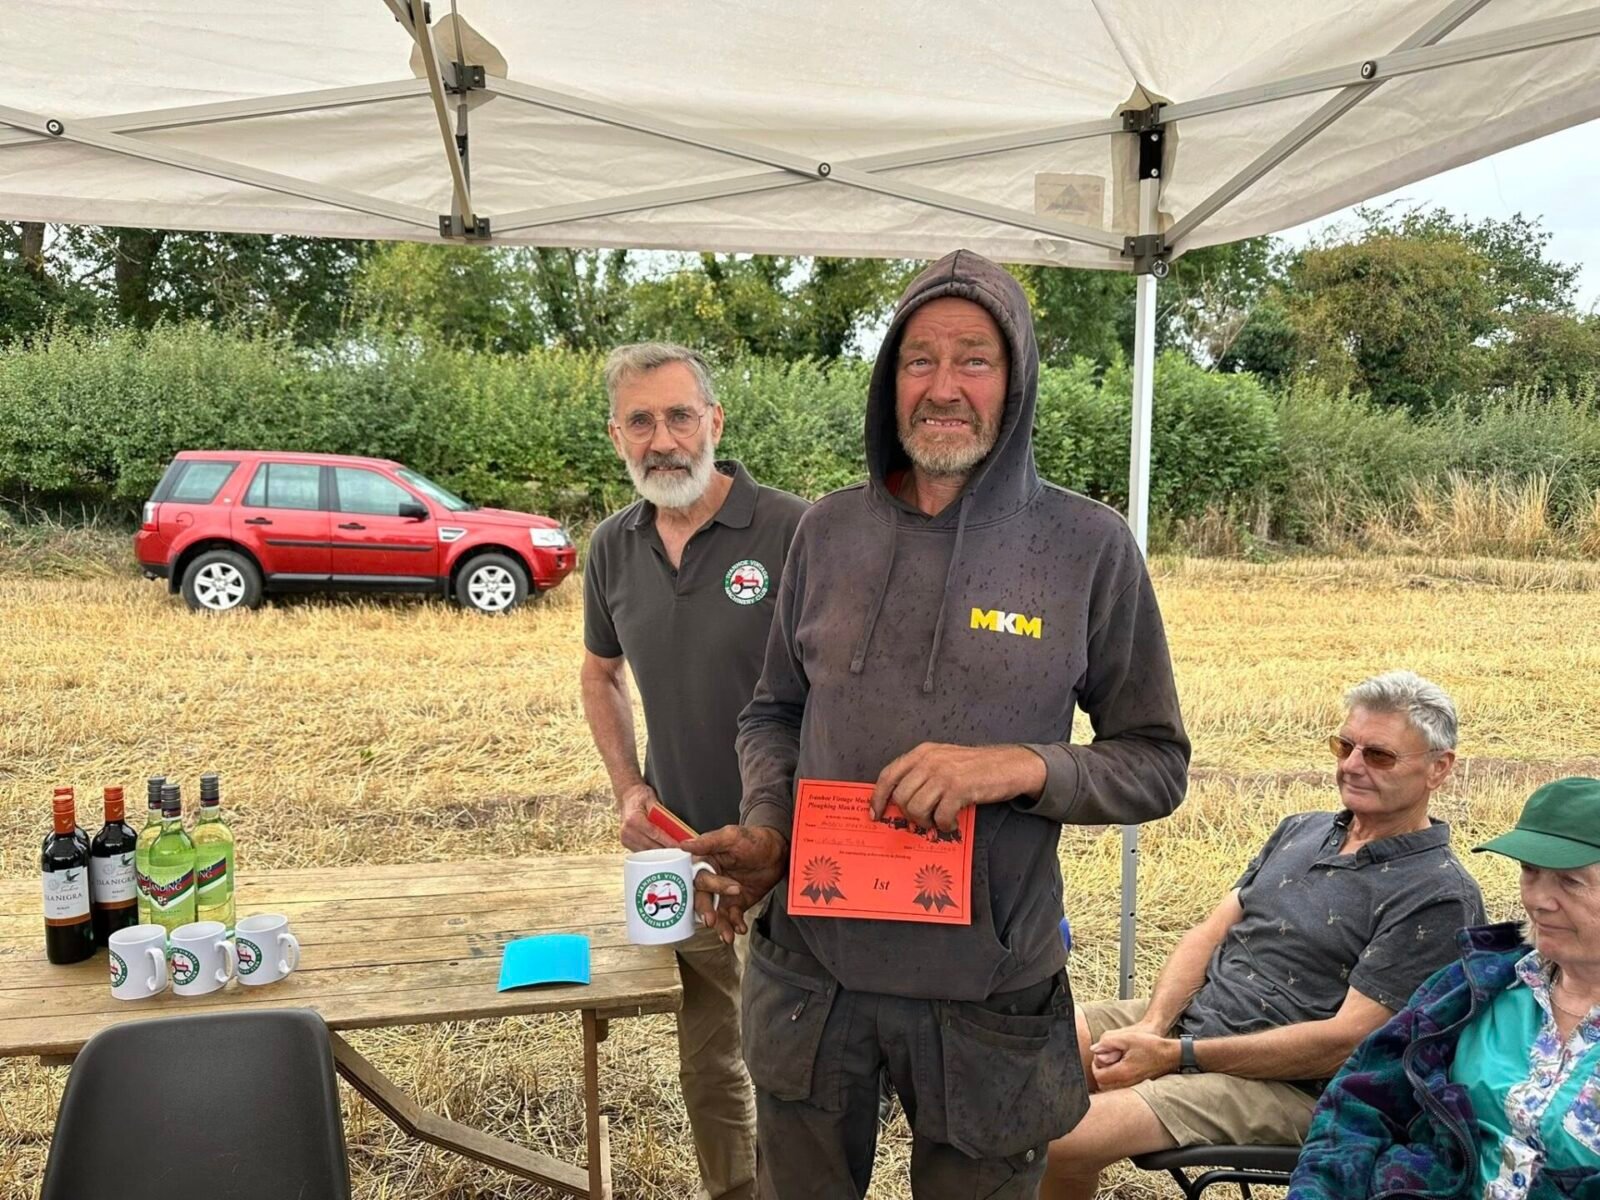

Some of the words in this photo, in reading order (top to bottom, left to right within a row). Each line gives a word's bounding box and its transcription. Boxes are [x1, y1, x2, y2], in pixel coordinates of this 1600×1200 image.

[970, 607, 1042, 639] MKM
[55, 892, 82, 901] NEGRA
[637, 874, 661, 898] IVANHOE
[664, 873, 687, 893] VINTAGE
[872, 878, 890, 891] 1st
[639, 907, 675, 928] MACHINERY
[676, 902, 687, 919] CLUB
